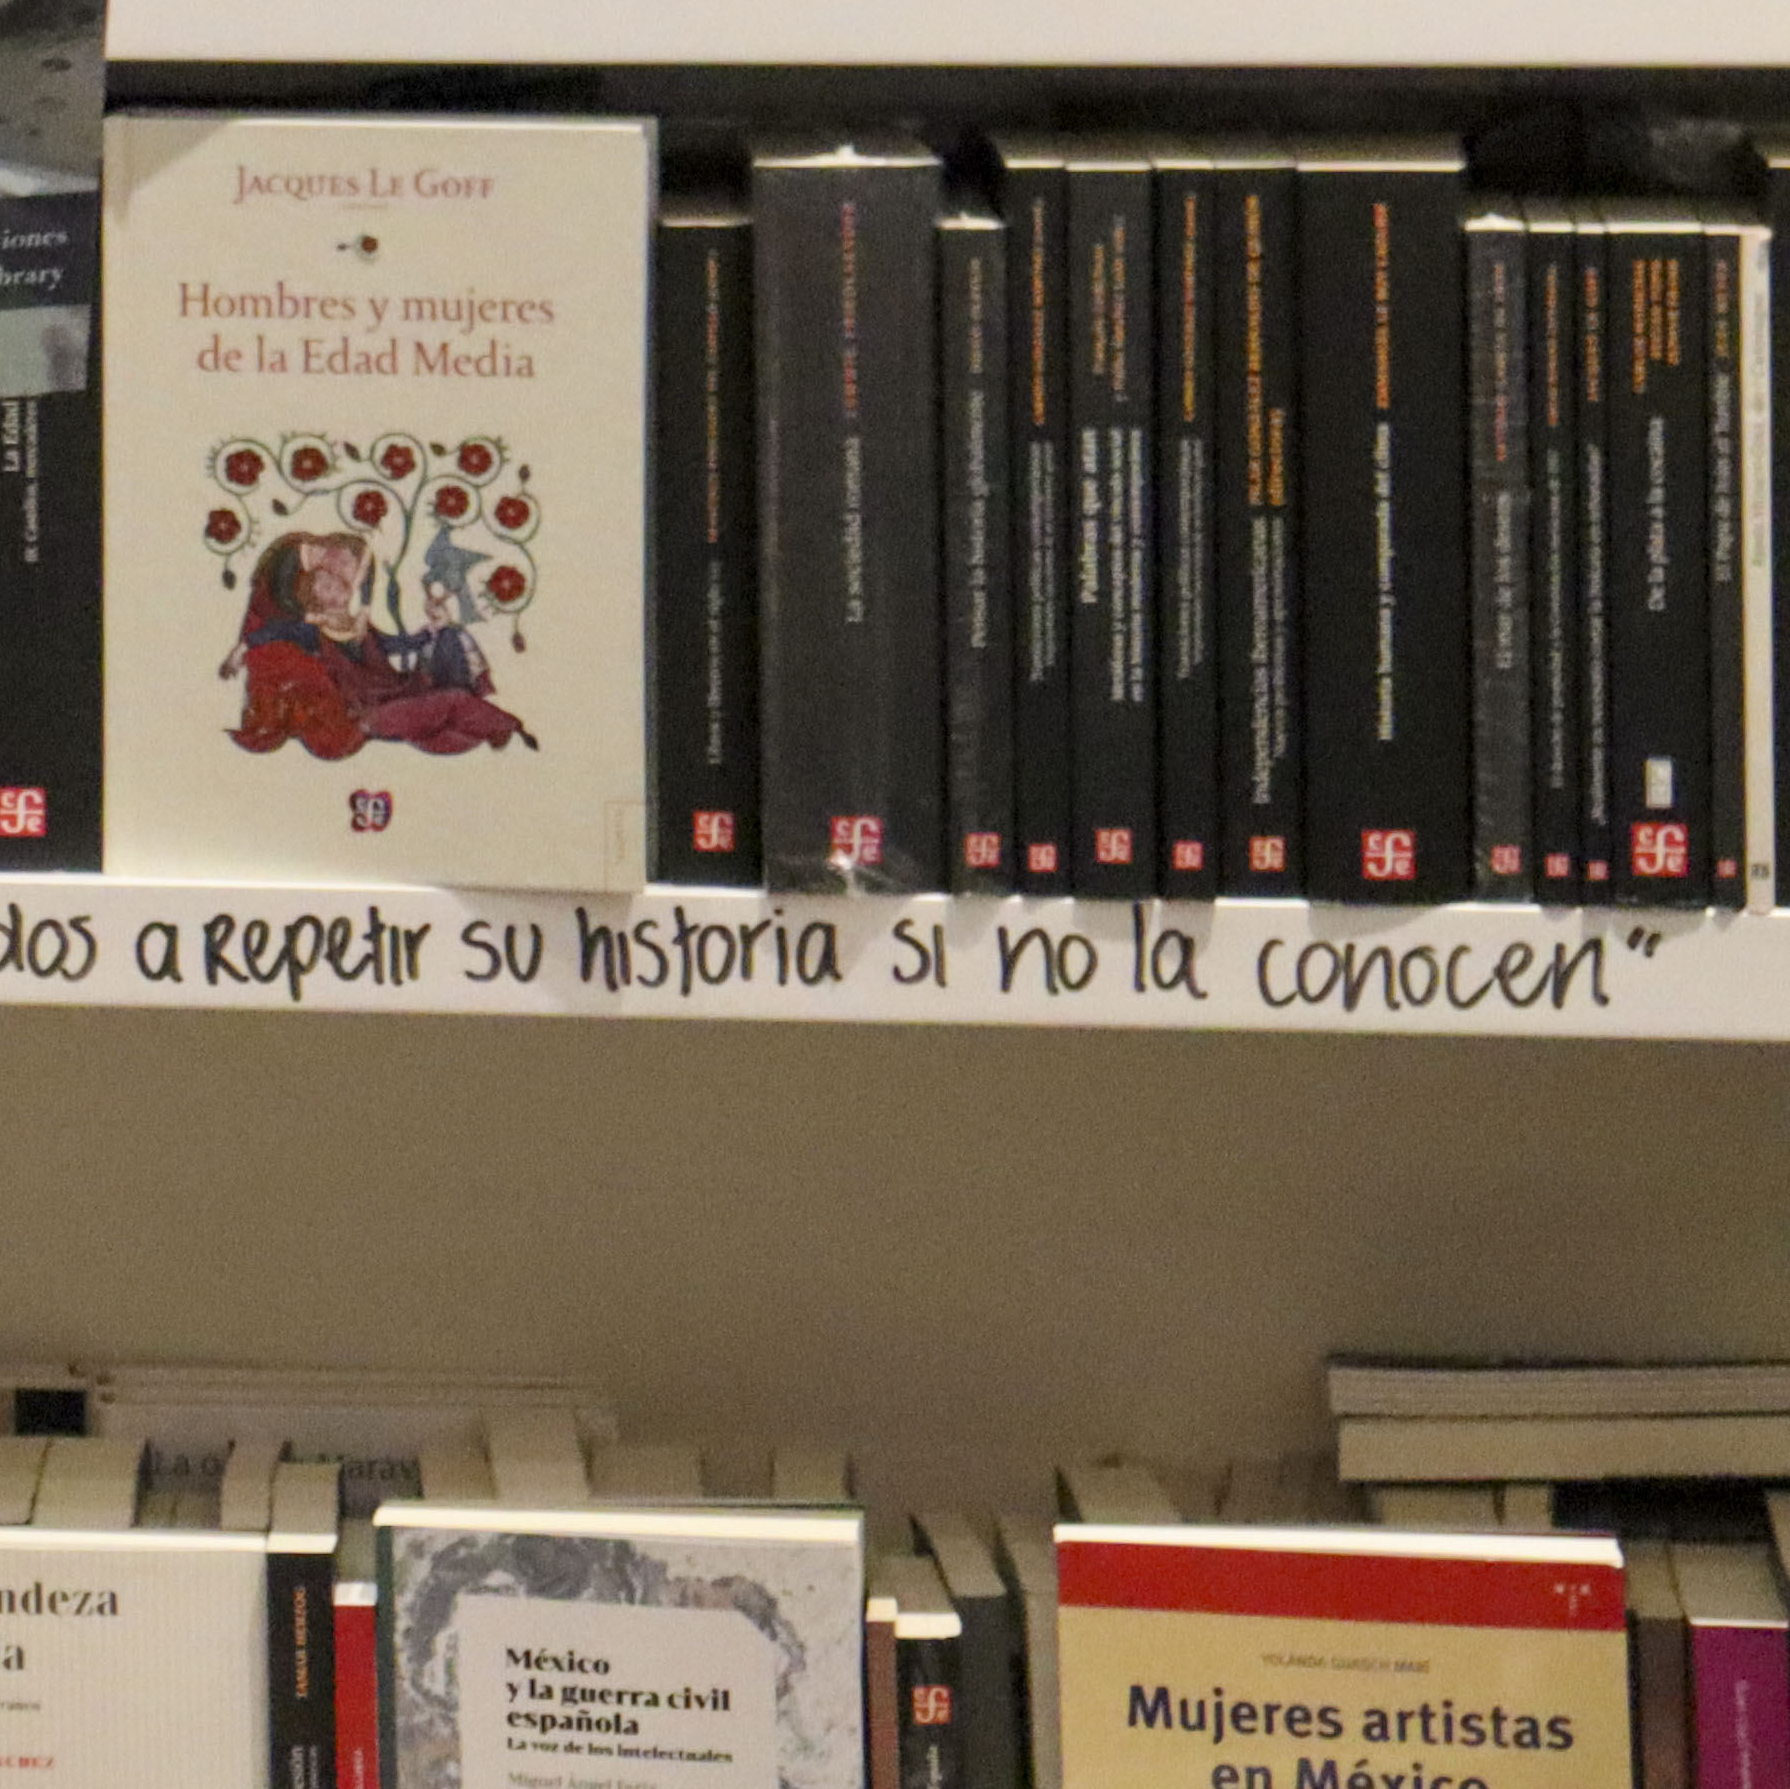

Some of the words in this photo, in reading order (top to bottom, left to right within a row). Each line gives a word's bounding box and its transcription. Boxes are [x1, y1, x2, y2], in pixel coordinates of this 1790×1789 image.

[178, 281, 357, 322] Hombres
[368, 293, 390, 335] y
[401, 287, 557, 335] mujeres
[196, 334, 243, 373] de
[257, 334, 288, 374] la
[302, 337, 401, 377] Edad
[413, 340, 537, 379] Media
[136, 922, 183, 983] a
[463, 923, 543, 983] su
[574, 904, 844, 997] historia
[892, 920, 948, 988] si
[997, 926, 1097, 996] no
[1132, 899, 1208, 1000] la
[505, 1647, 611, 1676] México
[504, 1682, 521, 1702] y
[528, 1678, 554, 1701] la
[560, 1684, 660, 1709] guerra
[666, 1688, 732, 1712] civil
[506, 1710, 641, 1736] española
[1127, 1684, 1345, 1745] Mujeres
[1361, 1699, 1575, 1752] artistas
[1210, 1762, 1274, 1789] en
